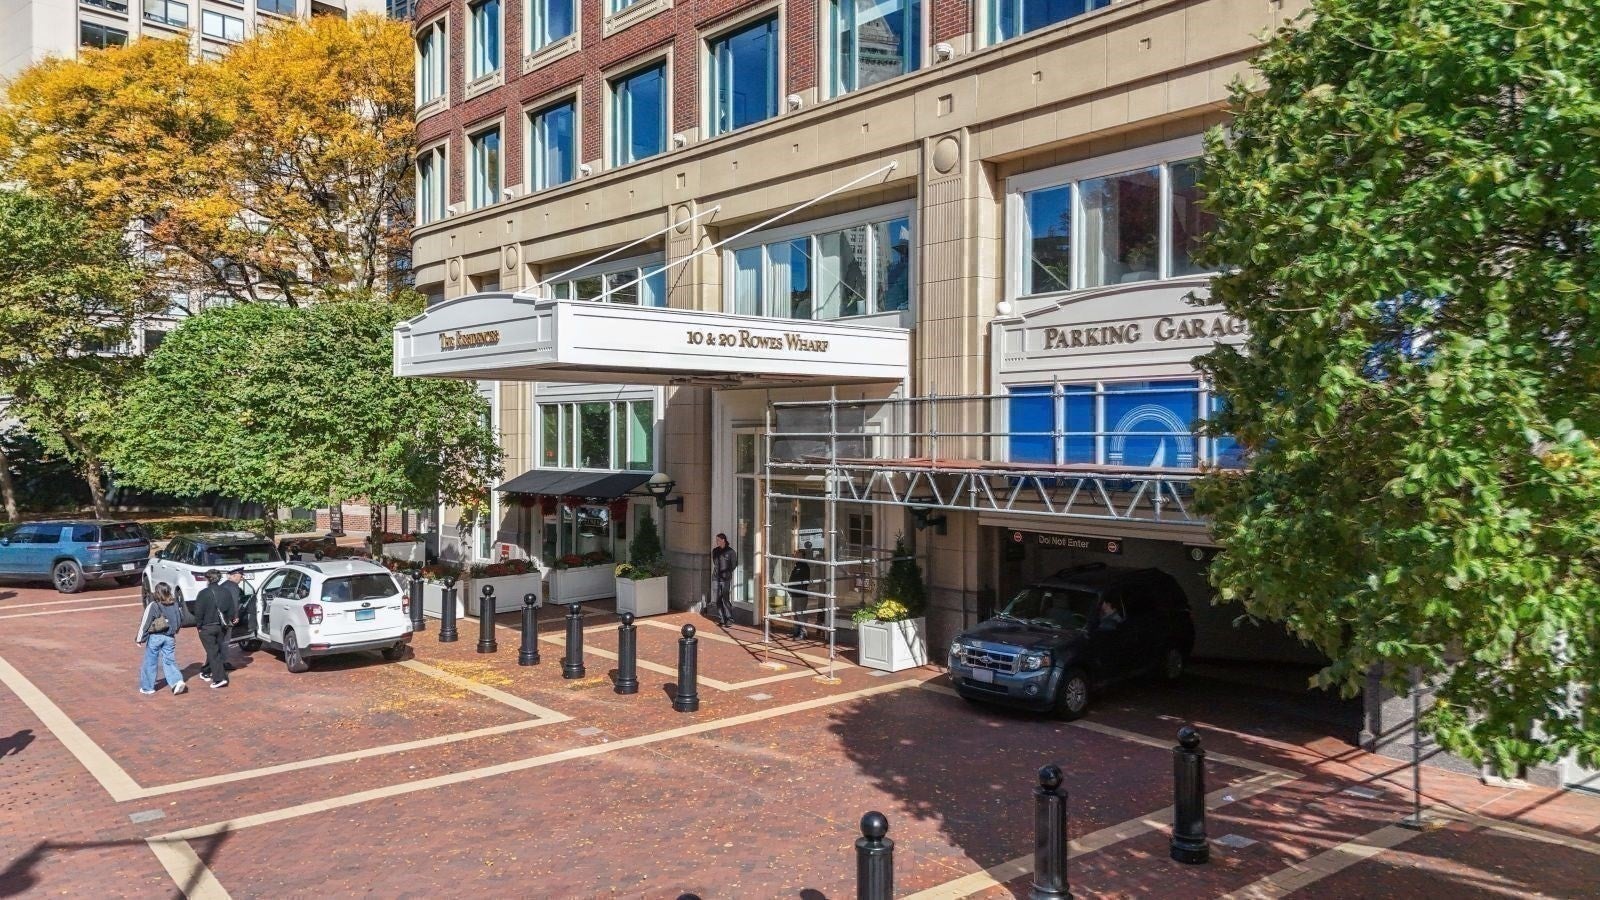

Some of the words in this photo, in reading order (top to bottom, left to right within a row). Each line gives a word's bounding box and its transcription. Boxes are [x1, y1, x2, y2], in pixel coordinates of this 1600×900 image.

[686, 331, 703, 344] 10
[706, 332, 716, 346] &
[718, 334, 736, 347] 20
[738, 329, 783, 350] ROWES
[784, 333, 829, 352] WHARF
[1044, 323, 1141, 350] PARKING
[1154, 316, 1245, 342] GARAG
[1038, 535, 1049, 544] Do
[1051, 536, 1066, 546] Not
[1067, 538, 1089, 548] Enter
